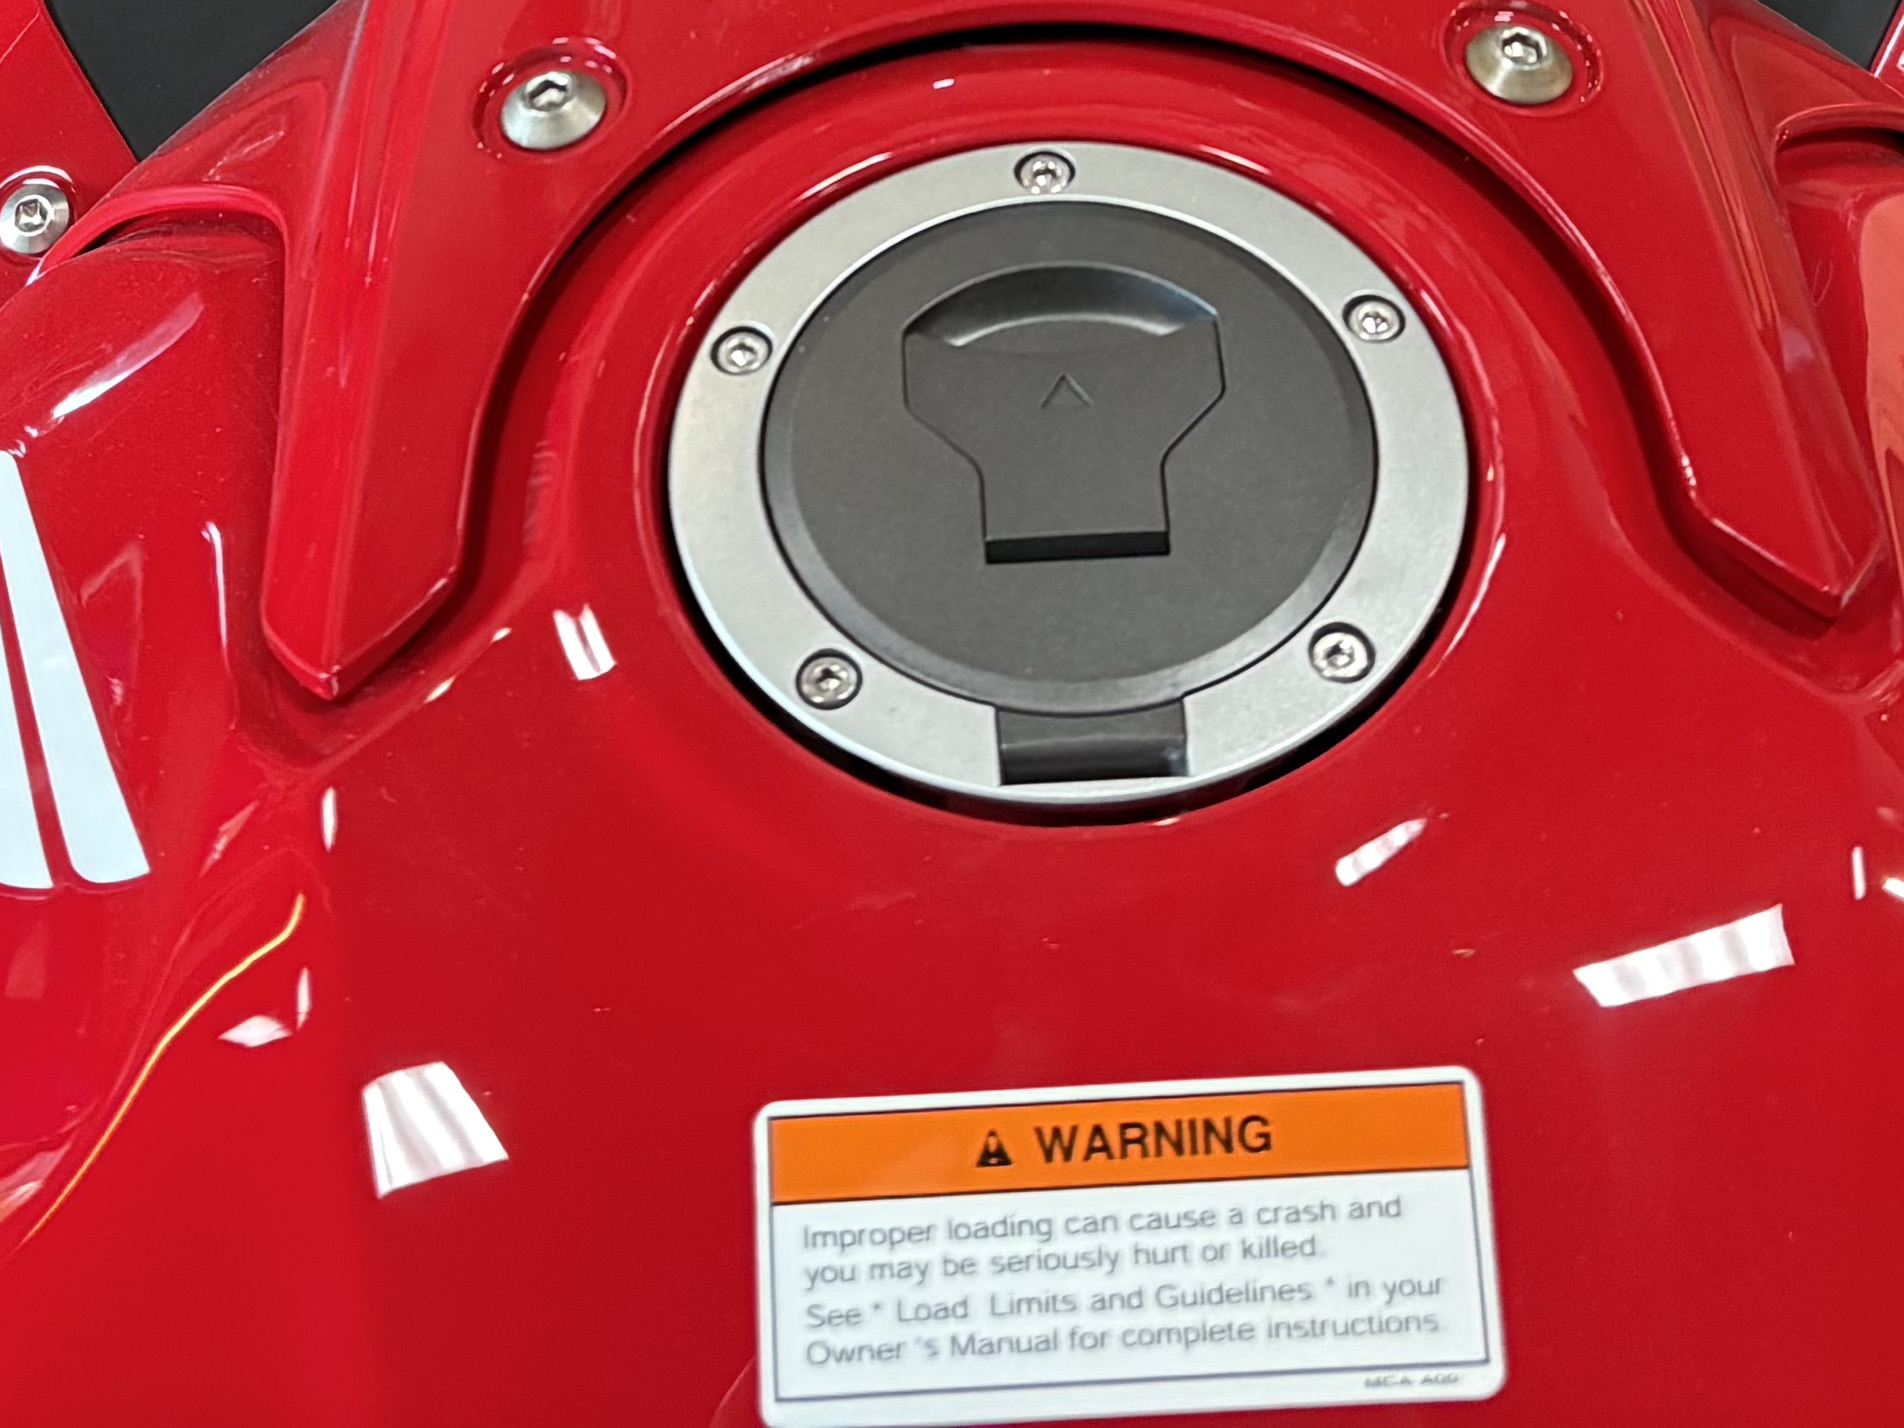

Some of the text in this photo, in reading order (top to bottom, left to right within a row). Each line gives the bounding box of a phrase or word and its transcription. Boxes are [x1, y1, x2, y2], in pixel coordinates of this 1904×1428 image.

[1034, 1114, 1274, 1165] WARNING
[803, 1195, 1402, 1253] Improper loading can cause a crash and
[803, 1262, 857, 1292] you
[869, 1258, 930, 1284] may
[943, 1253, 978, 1277] be
[990, 1245, 1120, 1275] seriously
[1133, 1240, 1189, 1266] hurt
[1201, 1242, 1227, 1263] or
[806, 1302, 863, 1329] See
[896, 1297, 969, 1323] Load
[989, 1291, 1077, 1318] Limits
[1091, 1285, 1144, 1310] and
[1155, 1277, 1313, 1309] Guidelines
[1347, 1276, 1371, 1299] in
[1383, 1276, 1444, 1306] your
[806, 1339, 904, 1366] Owner
[950, 1326, 1059, 1358] Manual
[1068, 1324, 1110, 1350] for
[1122, 1319, 1256, 1350] complete
